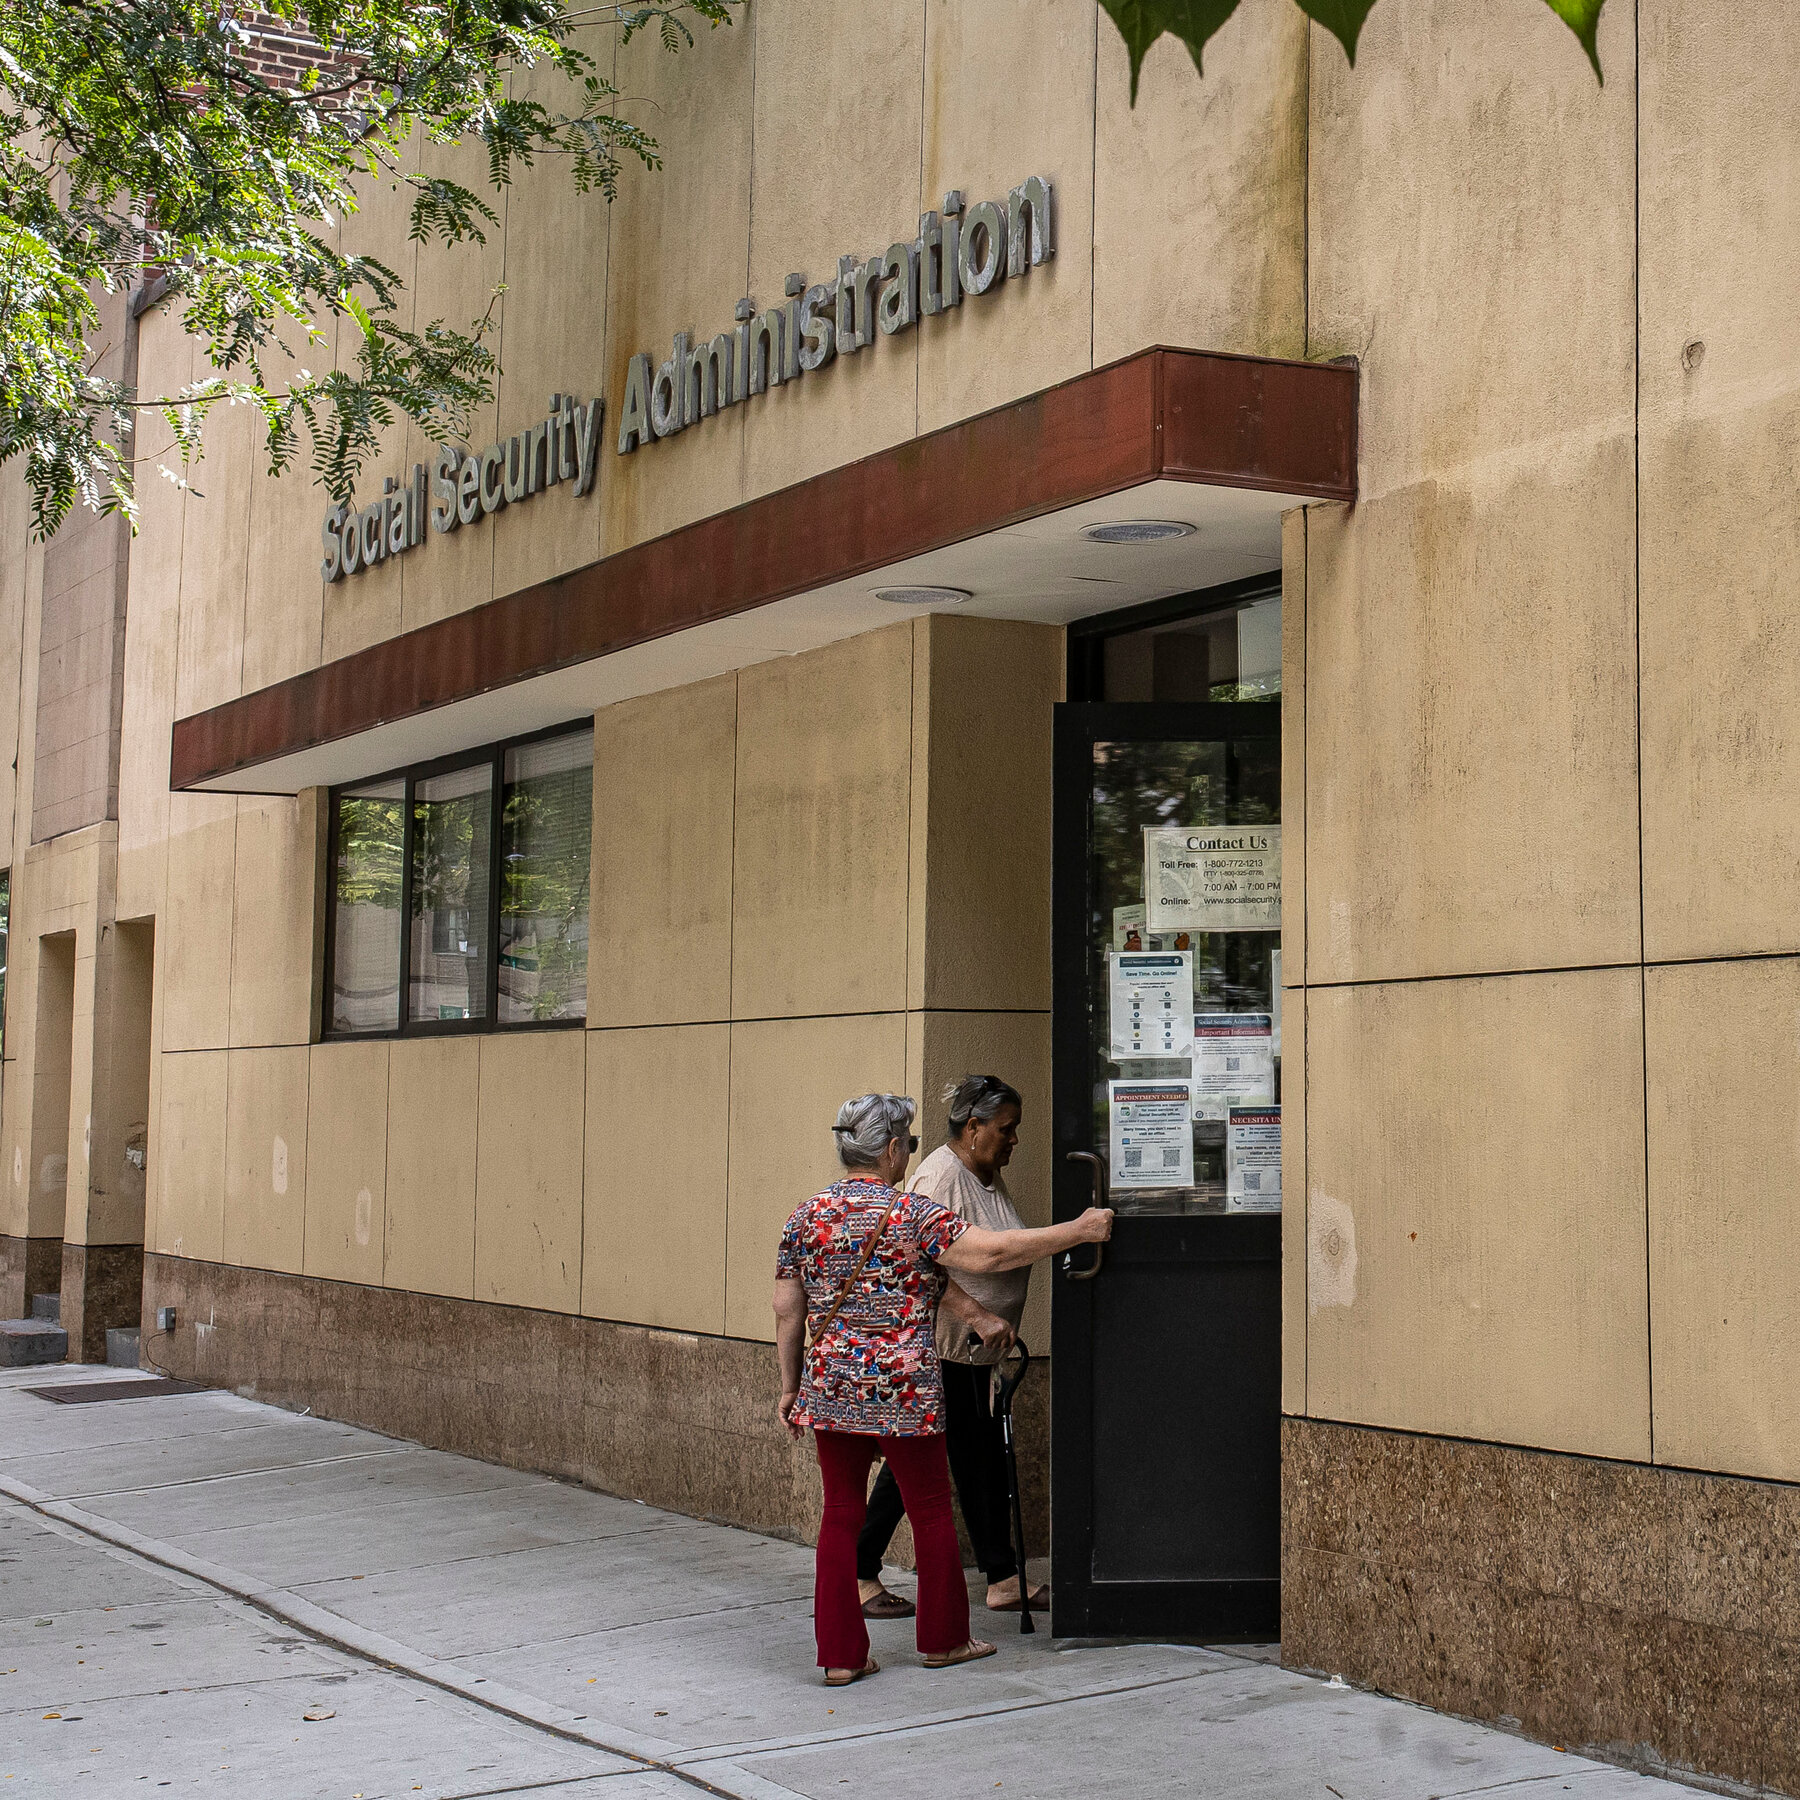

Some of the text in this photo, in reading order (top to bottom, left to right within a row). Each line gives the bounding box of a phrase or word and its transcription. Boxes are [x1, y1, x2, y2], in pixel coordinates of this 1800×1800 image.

[321, 176, 1055, 583] Social Security Administration
[1186, 835, 1268, 850] Contact Us
[1160, 859, 1263, 869] Toll Free: 1-800-772-1213
[1223, 883, 1237, 891] AM
[1247, 883, 1264, 891] 7:00
[1267, 882, 1280, 890] PM
[1160, 897, 1190, 905] Online:
[1231, 1028, 1266, 1036] Information
[1161, 1093, 1188, 1101] NEEDED
